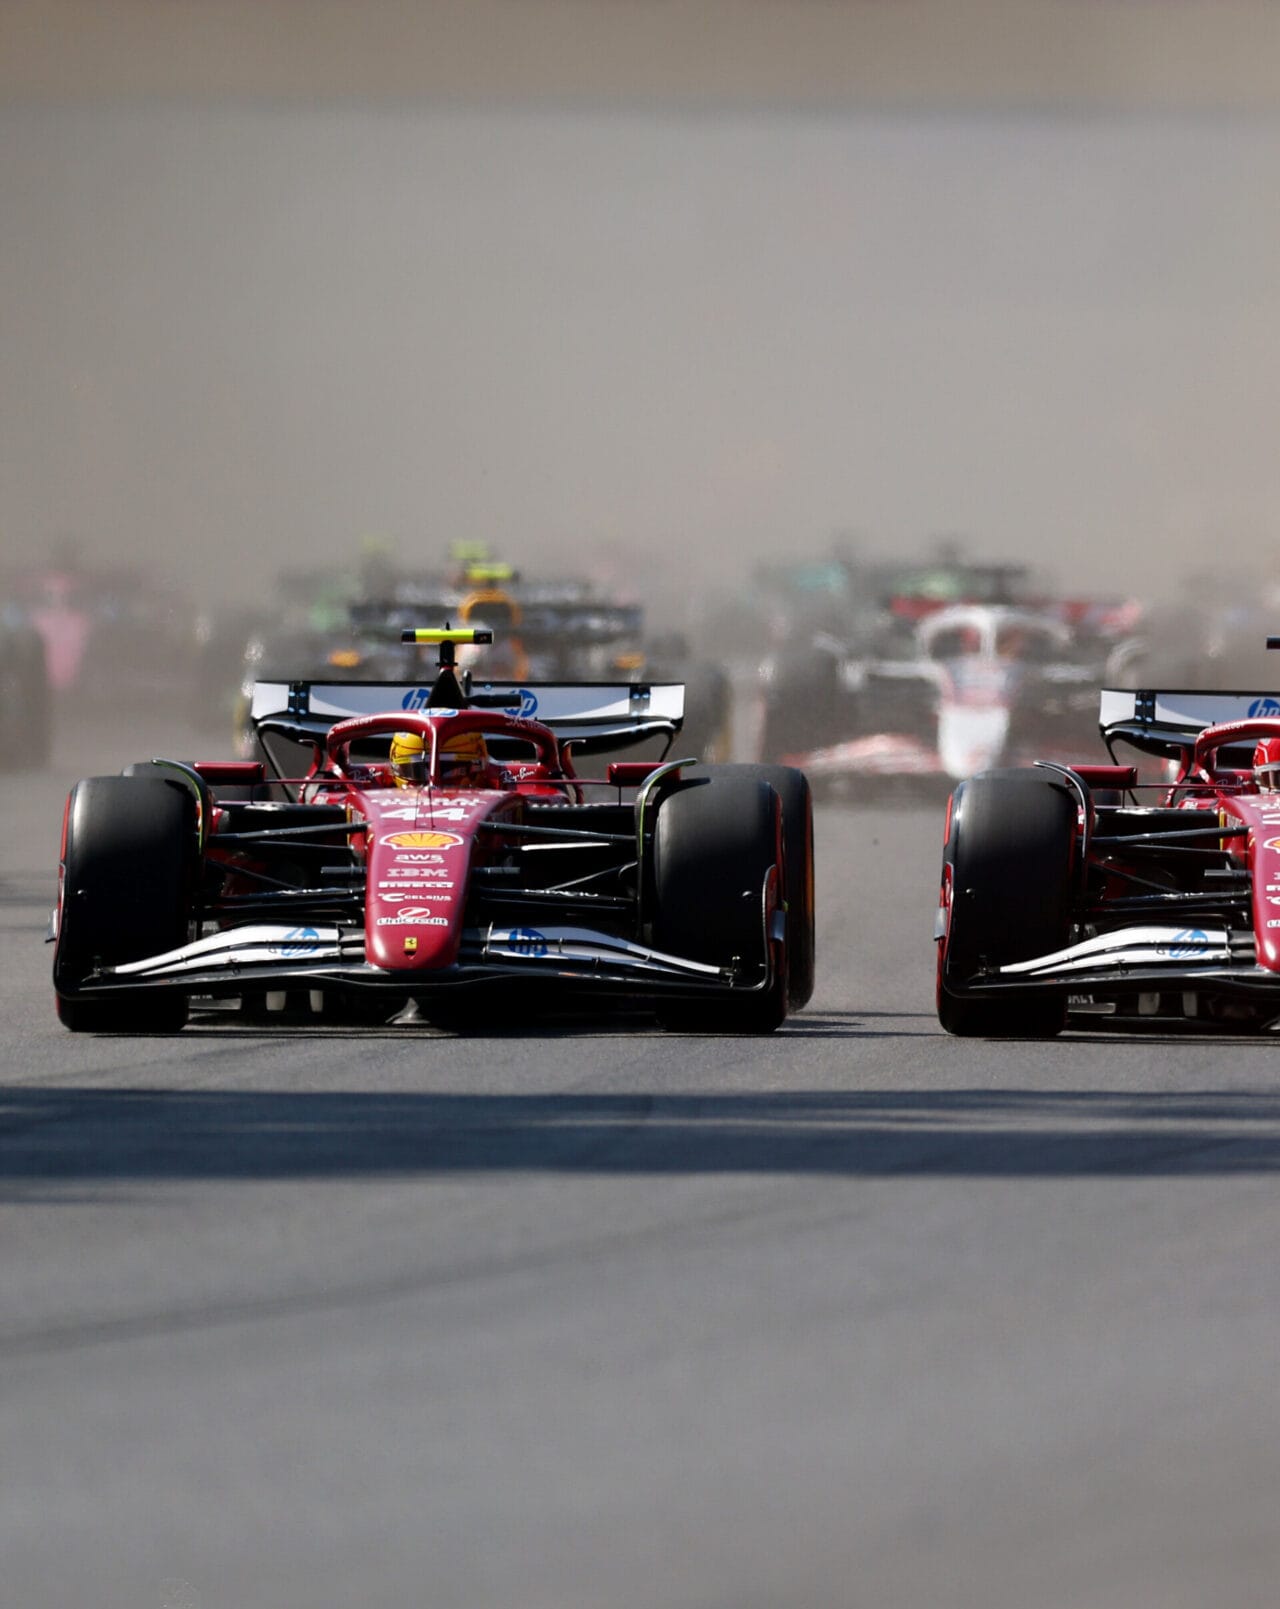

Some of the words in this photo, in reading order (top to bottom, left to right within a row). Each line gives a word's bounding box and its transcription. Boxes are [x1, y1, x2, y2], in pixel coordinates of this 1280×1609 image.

[380, 808, 470, 821] 44
[395, 854, 444, 863] aws
[387, 868, 448, 877] IBM
[376, 916, 449, 926] UniCredit
